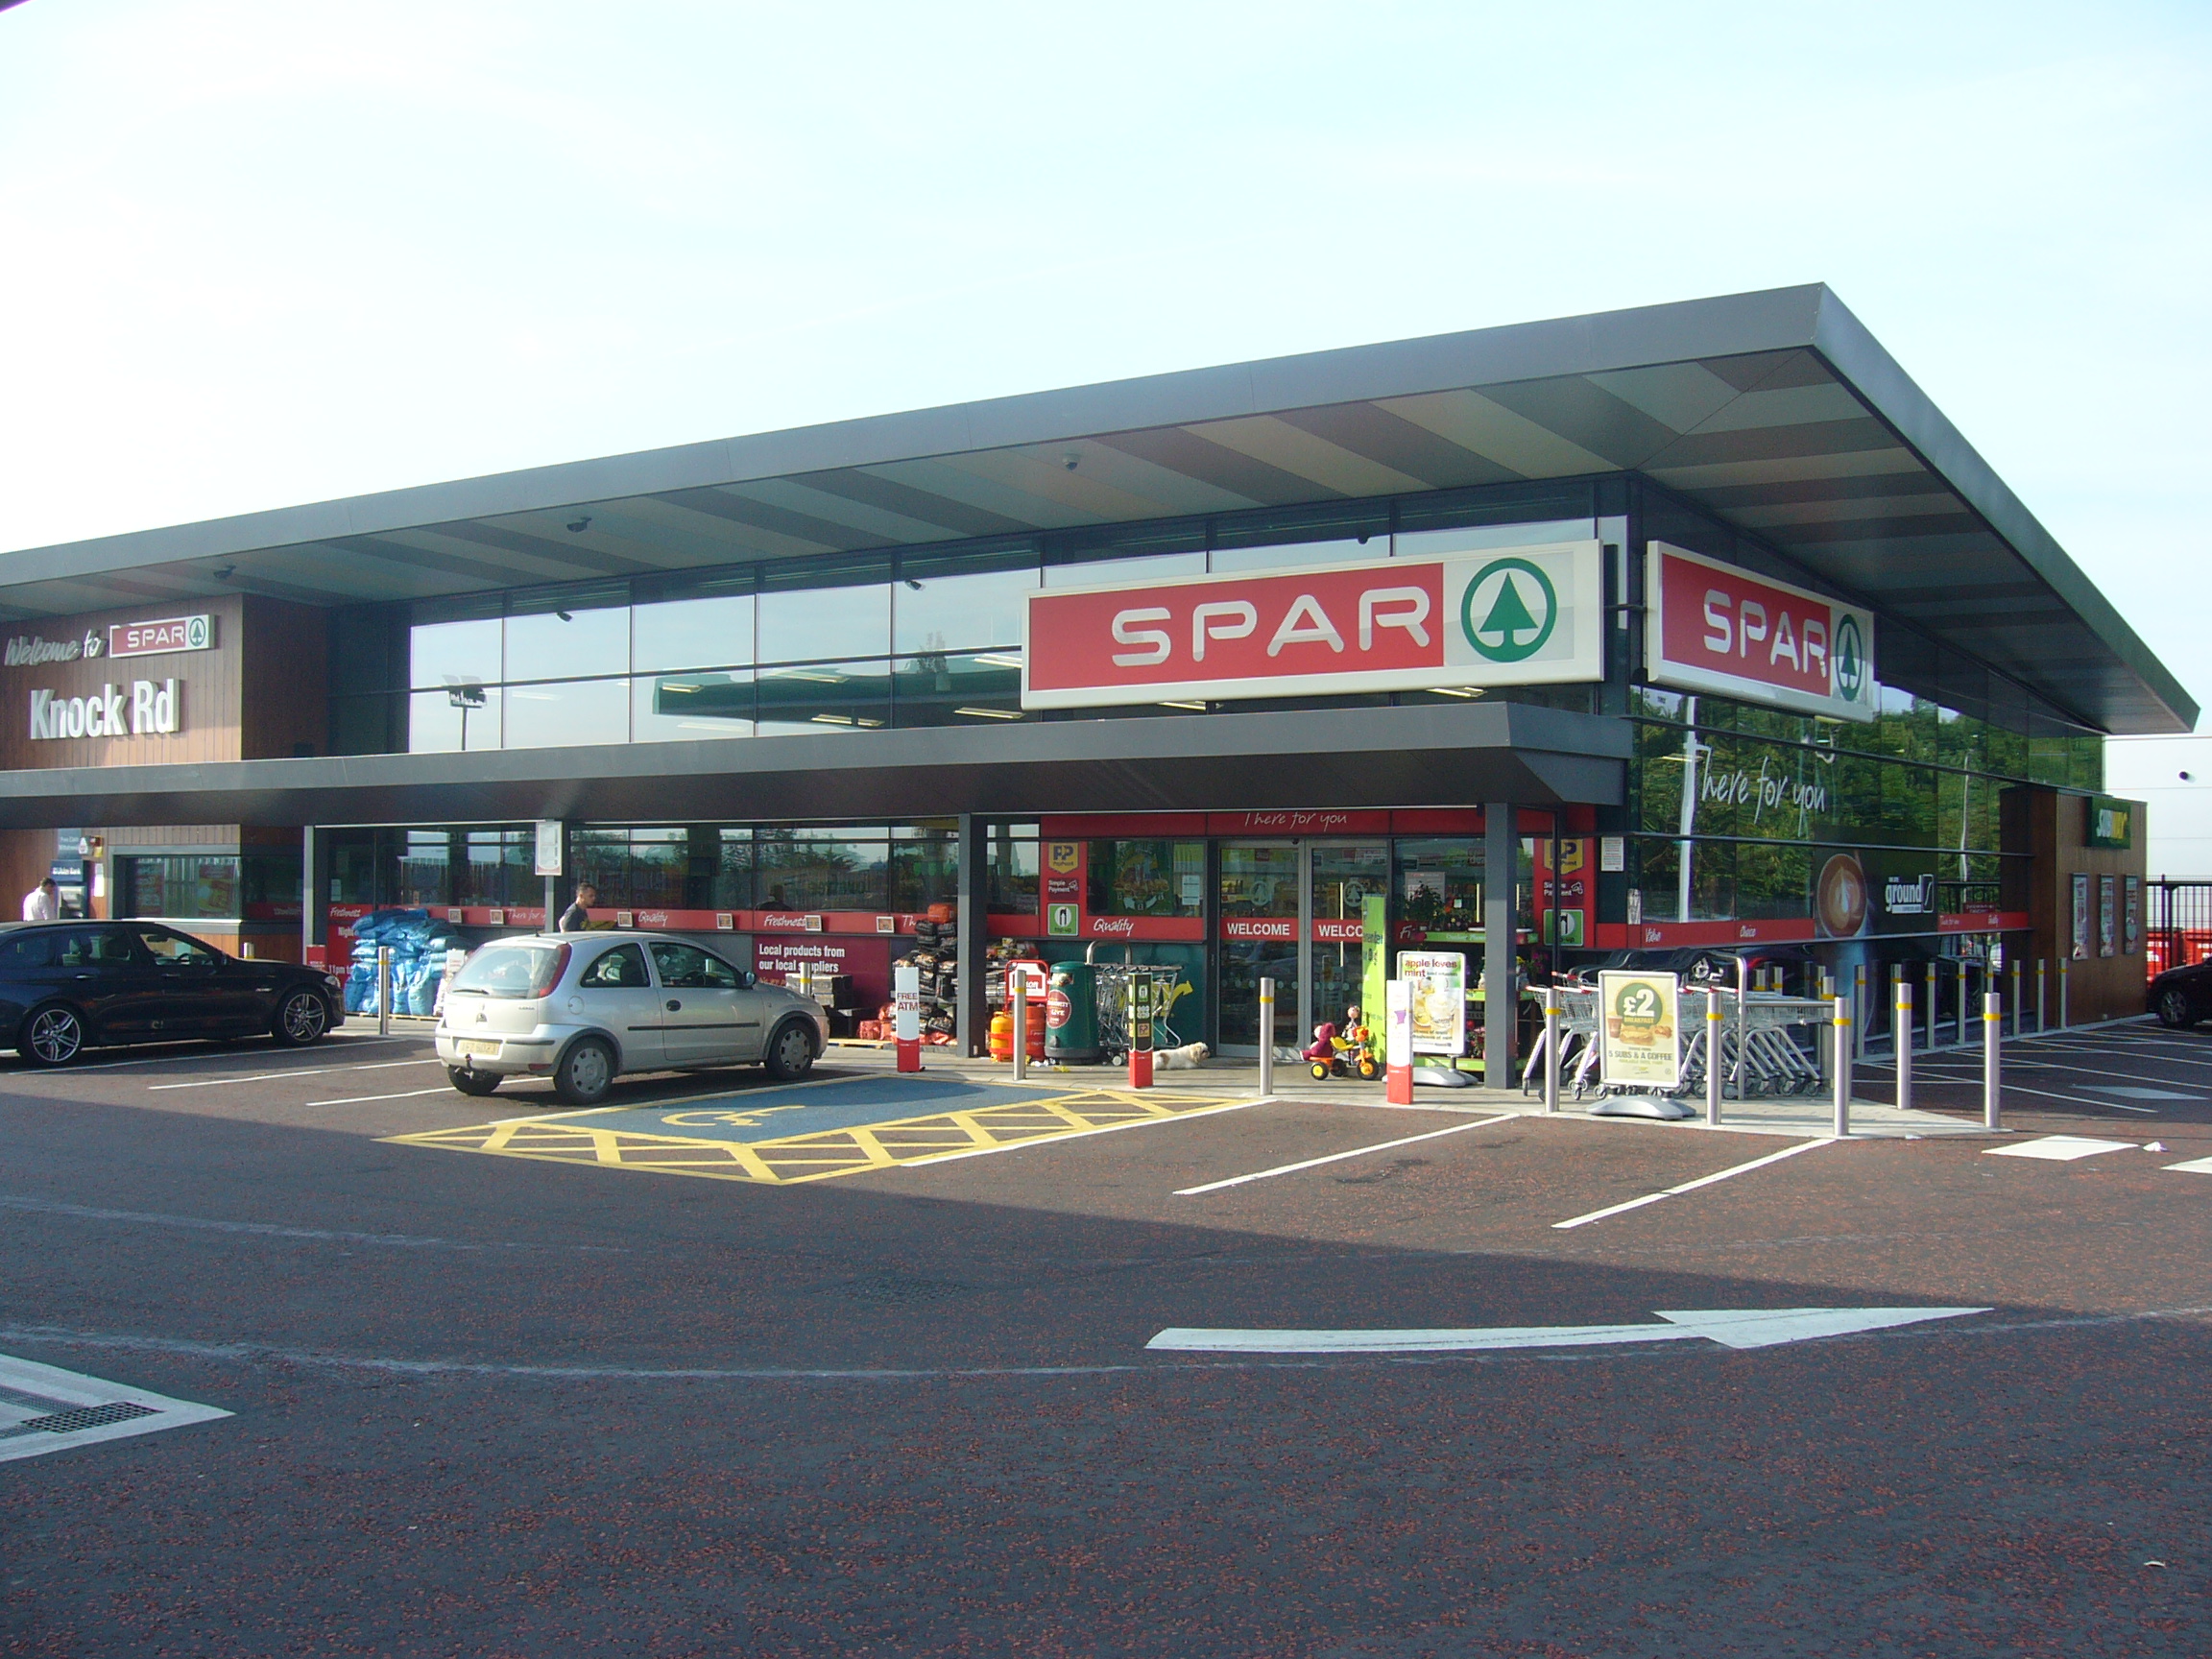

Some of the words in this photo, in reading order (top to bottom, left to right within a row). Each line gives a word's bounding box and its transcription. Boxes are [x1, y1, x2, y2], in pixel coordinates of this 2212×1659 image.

[1112, 586, 1431, 667] SPAR
[1703, 589, 1827, 678] SPAR
[127, 626, 185, 649] SPAR
[4, 635, 80, 666] Welcome
[84, 629, 104, 659] to
[31, 683, 128, 740] Knock
[132, 678, 180, 734] Rd
[1754, 755, 1788, 825] for
[1791, 782, 1825, 837] you
[1289, 811, 1316, 830] for
[1319, 814, 1347, 832] you
[1885, 874, 1922, 912] ground
[637, 910, 668, 926] Quality
[338, 926, 354, 938] Nigh
[1094, 918, 1134, 936] Quality
[1227, 923, 1290, 936] WELCOME
[1318, 924, 1363, 937] WELCO
[758, 943, 781, 956] Local
[783, 945, 823, 958] products
[824, 945, 845, 958] from
[758, 961, 774, 971] our
[776, 959, 796, 971] local
[1405, 958, 1431, 969] apple
[1431, 958, 1457, 969] loves
[1405, 969, 1425, 977] mint
[897, 992, 918, 1000] FREE
[1623, 988, 1655, 1017] £2
[898, 1001, 919, 1011] ATM
[1615, 1050, 1633, 1059] SUBS
[1647, 1052, 1672, 1061] COFFEE
